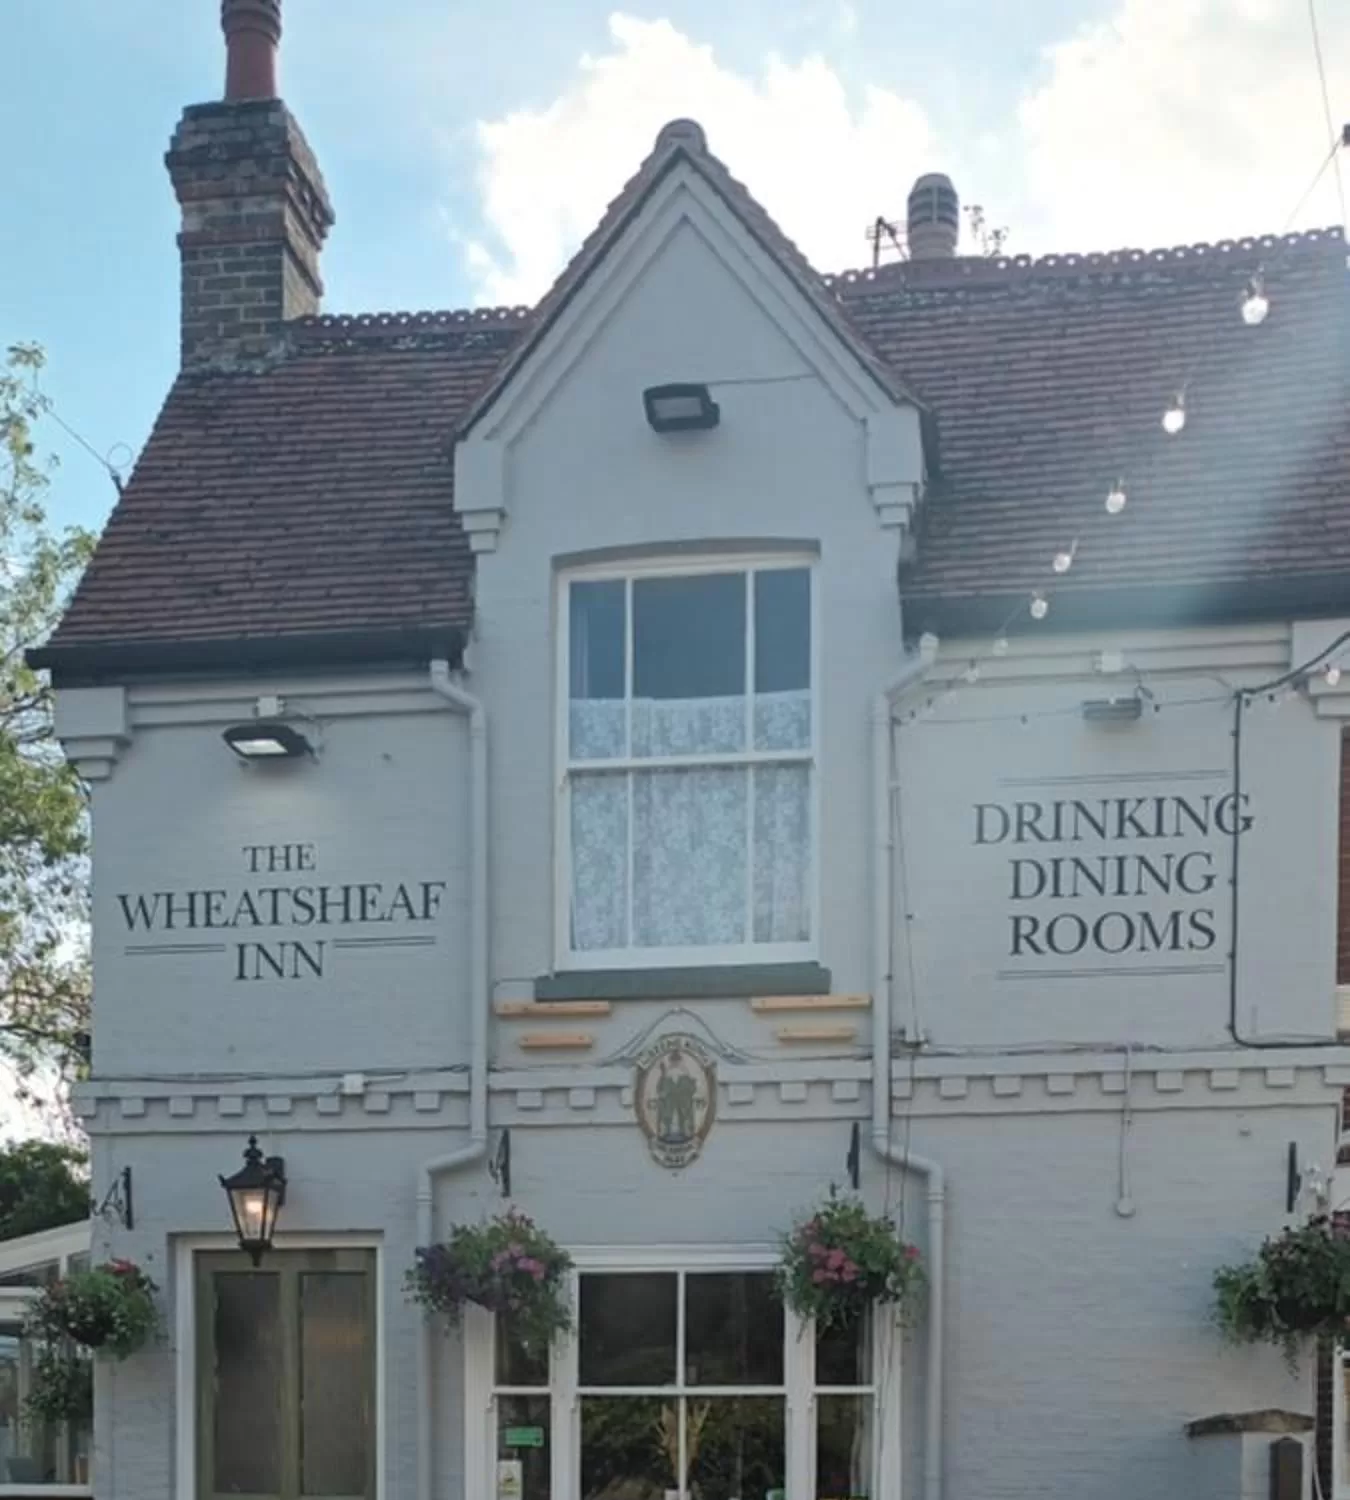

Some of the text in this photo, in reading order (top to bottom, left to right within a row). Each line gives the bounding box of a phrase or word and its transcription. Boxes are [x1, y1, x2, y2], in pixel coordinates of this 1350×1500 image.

[974, 792, 1254, 845] DRINKING
[242, 844, 317, 873] THE
[1009, 852, 1217, 900] DINING
[117, 881, 447, 931] WHEATSHEAF
[1008, 908, 1217, 956] ROOMS
[234, 940, 325, 981] INN
